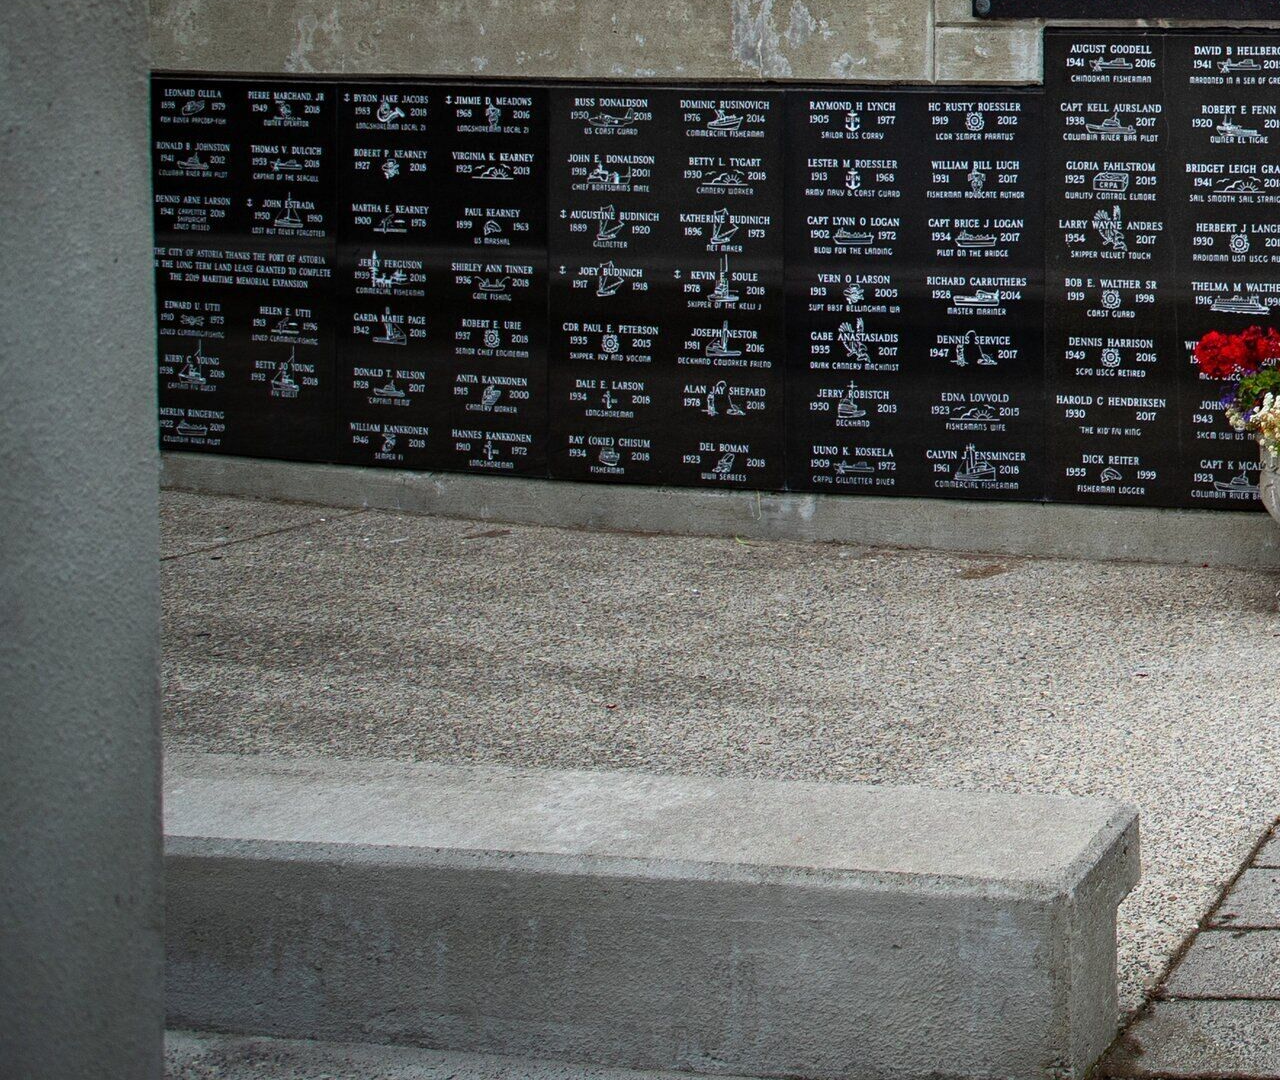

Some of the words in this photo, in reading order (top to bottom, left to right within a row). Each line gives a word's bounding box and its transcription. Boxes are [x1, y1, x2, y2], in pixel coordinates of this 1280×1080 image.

[1070, 45, 1106, 53] AUGUST
[1110, 45, 1152, 54] GOODELL
[1067, 58, 1084, 66] 1941
[1135, 59, 1155, 67] 2016
[575, 98, 595, 106] RUSS
[600, 99, 647, 107] DONALDSON
[1061, 103, 1083, 111] CAPT
[1088, 103, 1109, 112] KELL
[1113, 104, 1161, 113] AURSLAND
[1202, 105, 1236, 114] ROBERT
[1241, 106, 1246, 114] E
[1252, 106, 1276, 114] FENN
[571, 111, 591, 119] 1950
[633, 112, 652, 120] 2018
[1065, 116, 1086, 126] 1938
[1136, 117, 1156, 126] 2017
[1192, 119, 1212, 127] 1920
[465, 208, 482, 216] PAUL
[486, 209, 520, 217] KEARNEY
[807, 216, 828, 225] CAPT
[833, 217, 855, 225] LYNN
[860, 217, 866, 226] O
[871, 218, 899, 226] LOGAN
[811, 230, 829, 238] 1902
[879, 231, 896, 240] 1972
[1069, 337, 1102, 346] DENNIS
[1107, 338, 1153, 348] HARRISON
[1066, 351, 1085, 359] 1949
[1136, 353, 1156, 362] 2016
[942, 393, 965, 401] EDNA
[970, 394, 1009, 402] LOVVOLD
[932, 406, 950, 414] 1923
[1000, 407, 1019, 416] 2015
[700, 443, 715, 451] DEL
[720, 444, 748, 454] BOMAN
[683, 455, 700, 463] 1923
[747, 458, 765, 467] 2018
